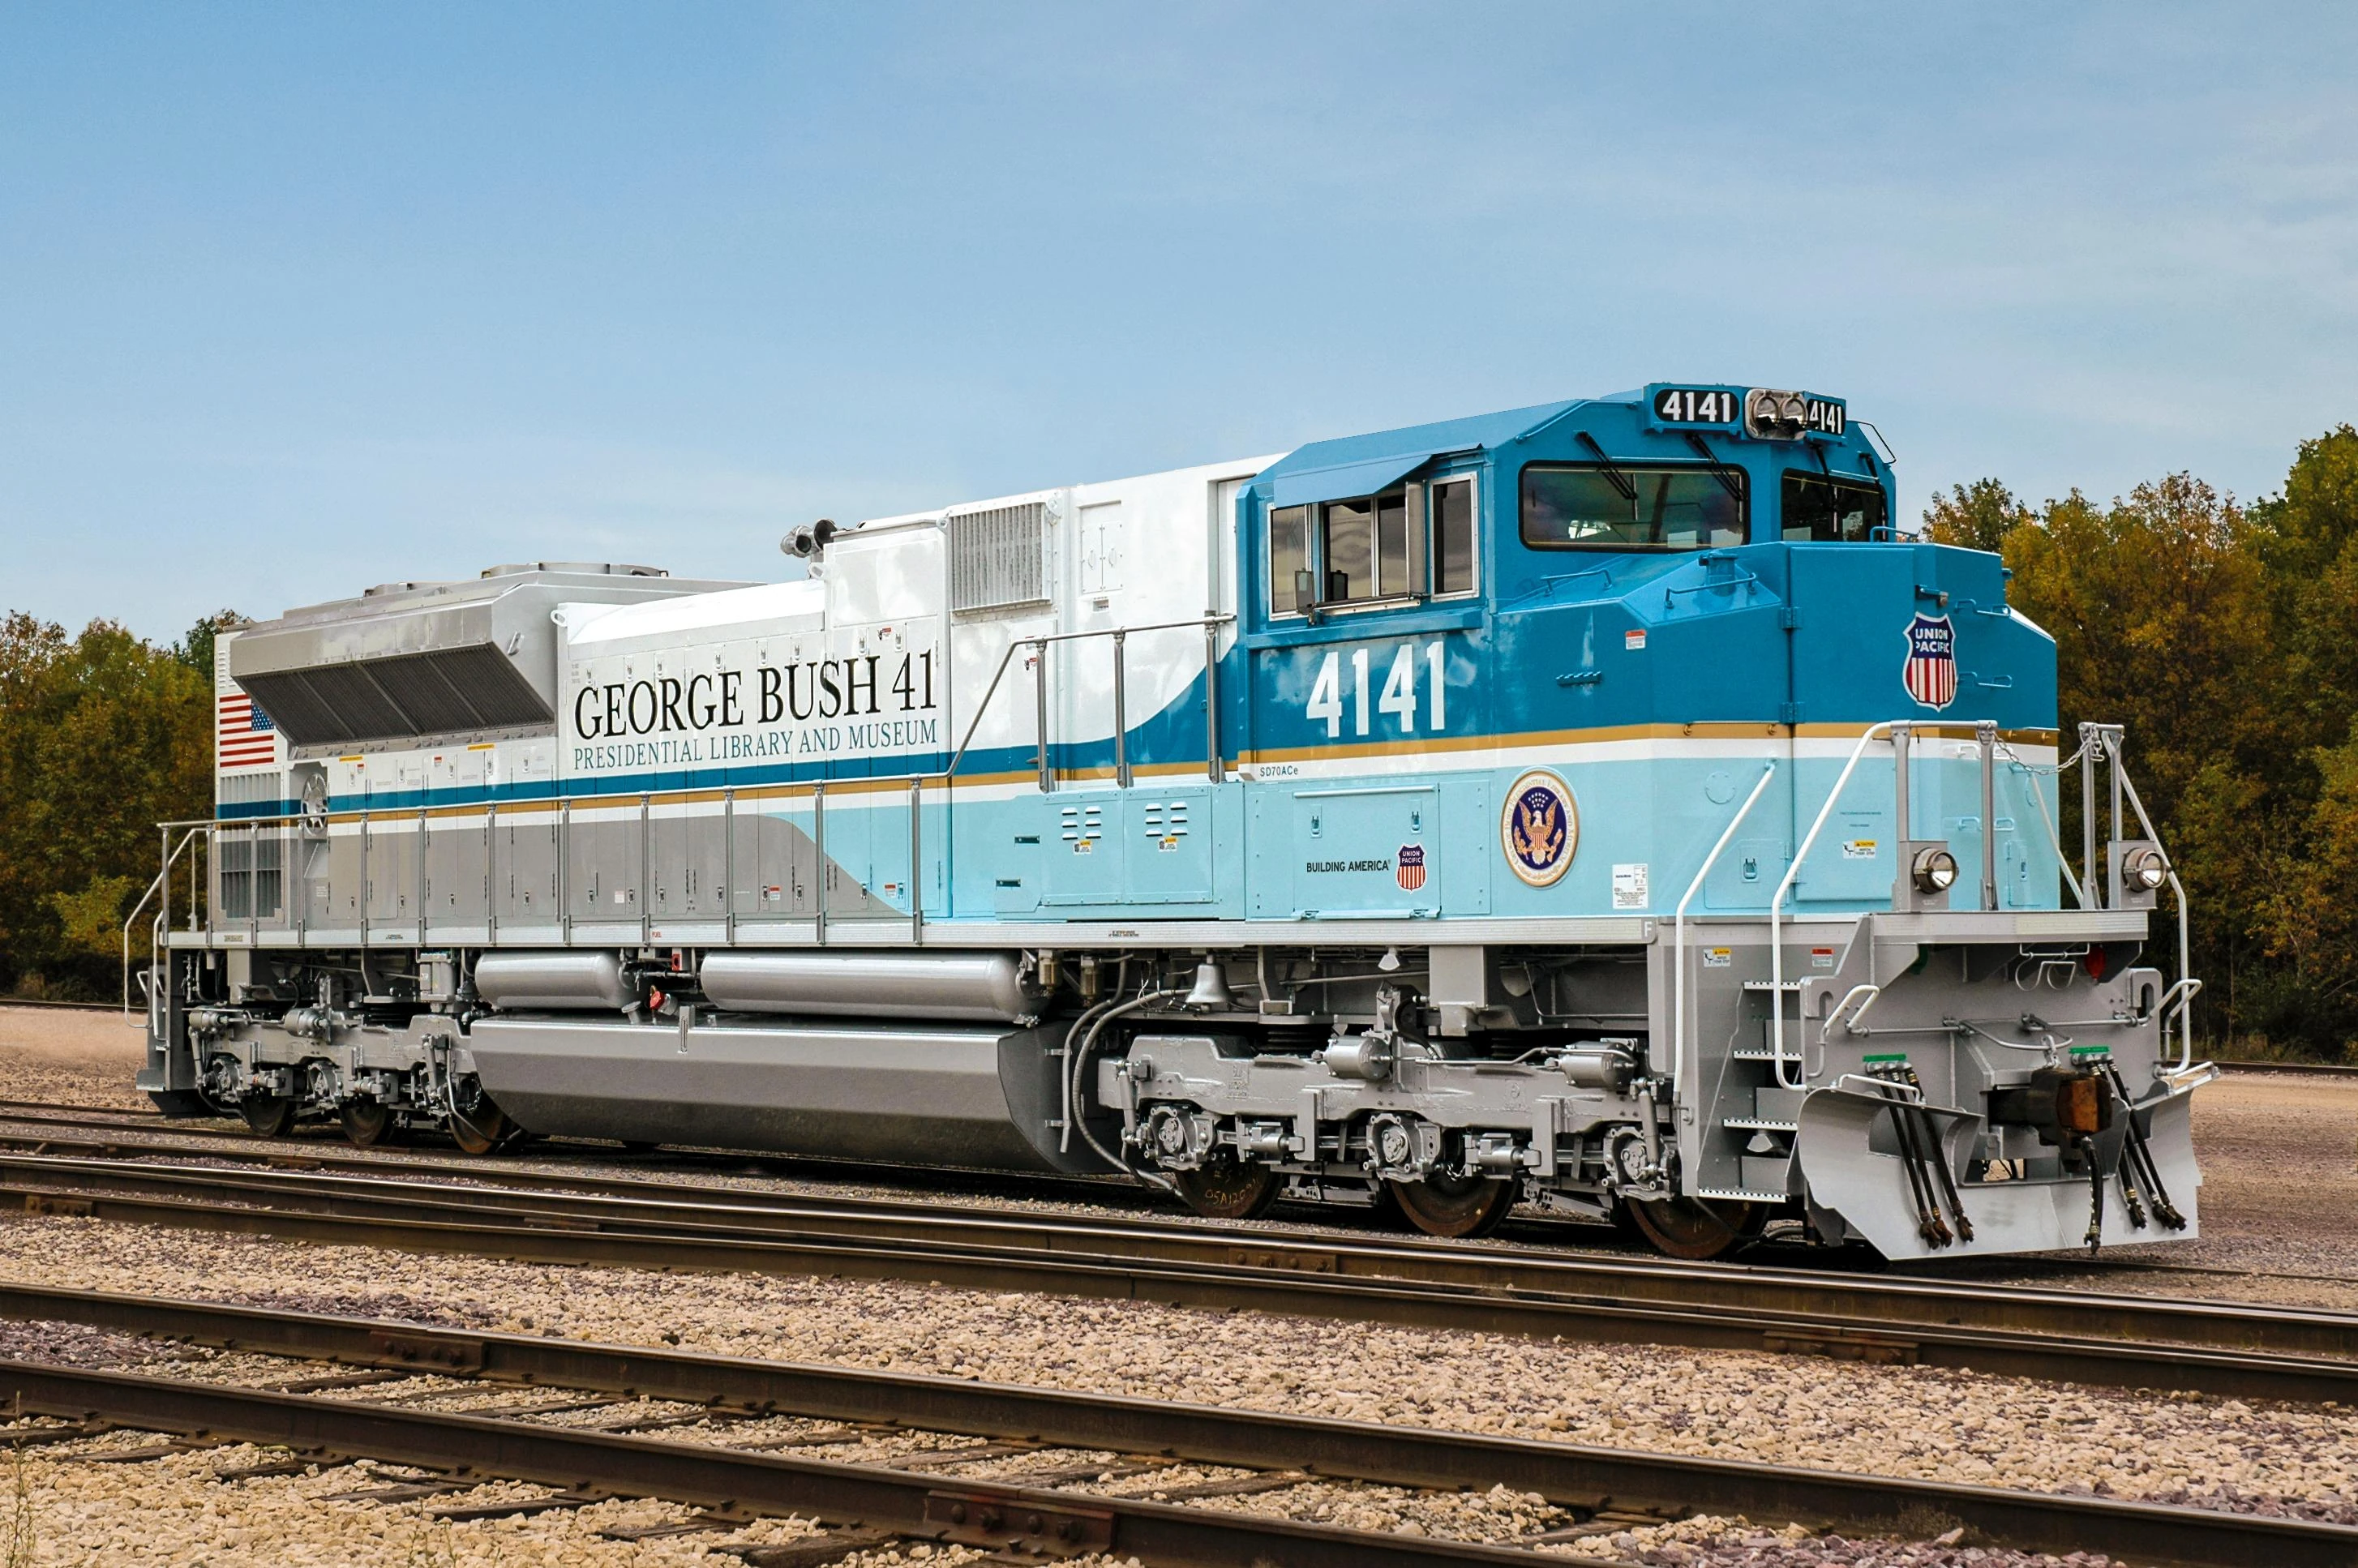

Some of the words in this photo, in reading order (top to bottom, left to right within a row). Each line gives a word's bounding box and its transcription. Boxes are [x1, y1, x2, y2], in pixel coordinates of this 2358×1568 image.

[1662, 391, 1730, 422] 4141
[1809, 401, 1842, 435] 4141
[1915, 628, 1949, 640] UNION
[574, 670, 744, 739] GEORGE
[757, 655, 881, 723] BUSH
[892, 648, 937, 711] 41
[1306, 641, 1445, 738] 4141
[574, 739, 703, 770] PRESIDENTIAL
[710, 730, 793, 760] LIBRARY
[800, 726, 841, 753] AND
[848, 718, 937, 749] MUSEUM
[1260, 765, 1298, 777] SD70ACe
[1306, 861, 1345, 872] BUILDING
[1644, 921, 1653, 937] F
